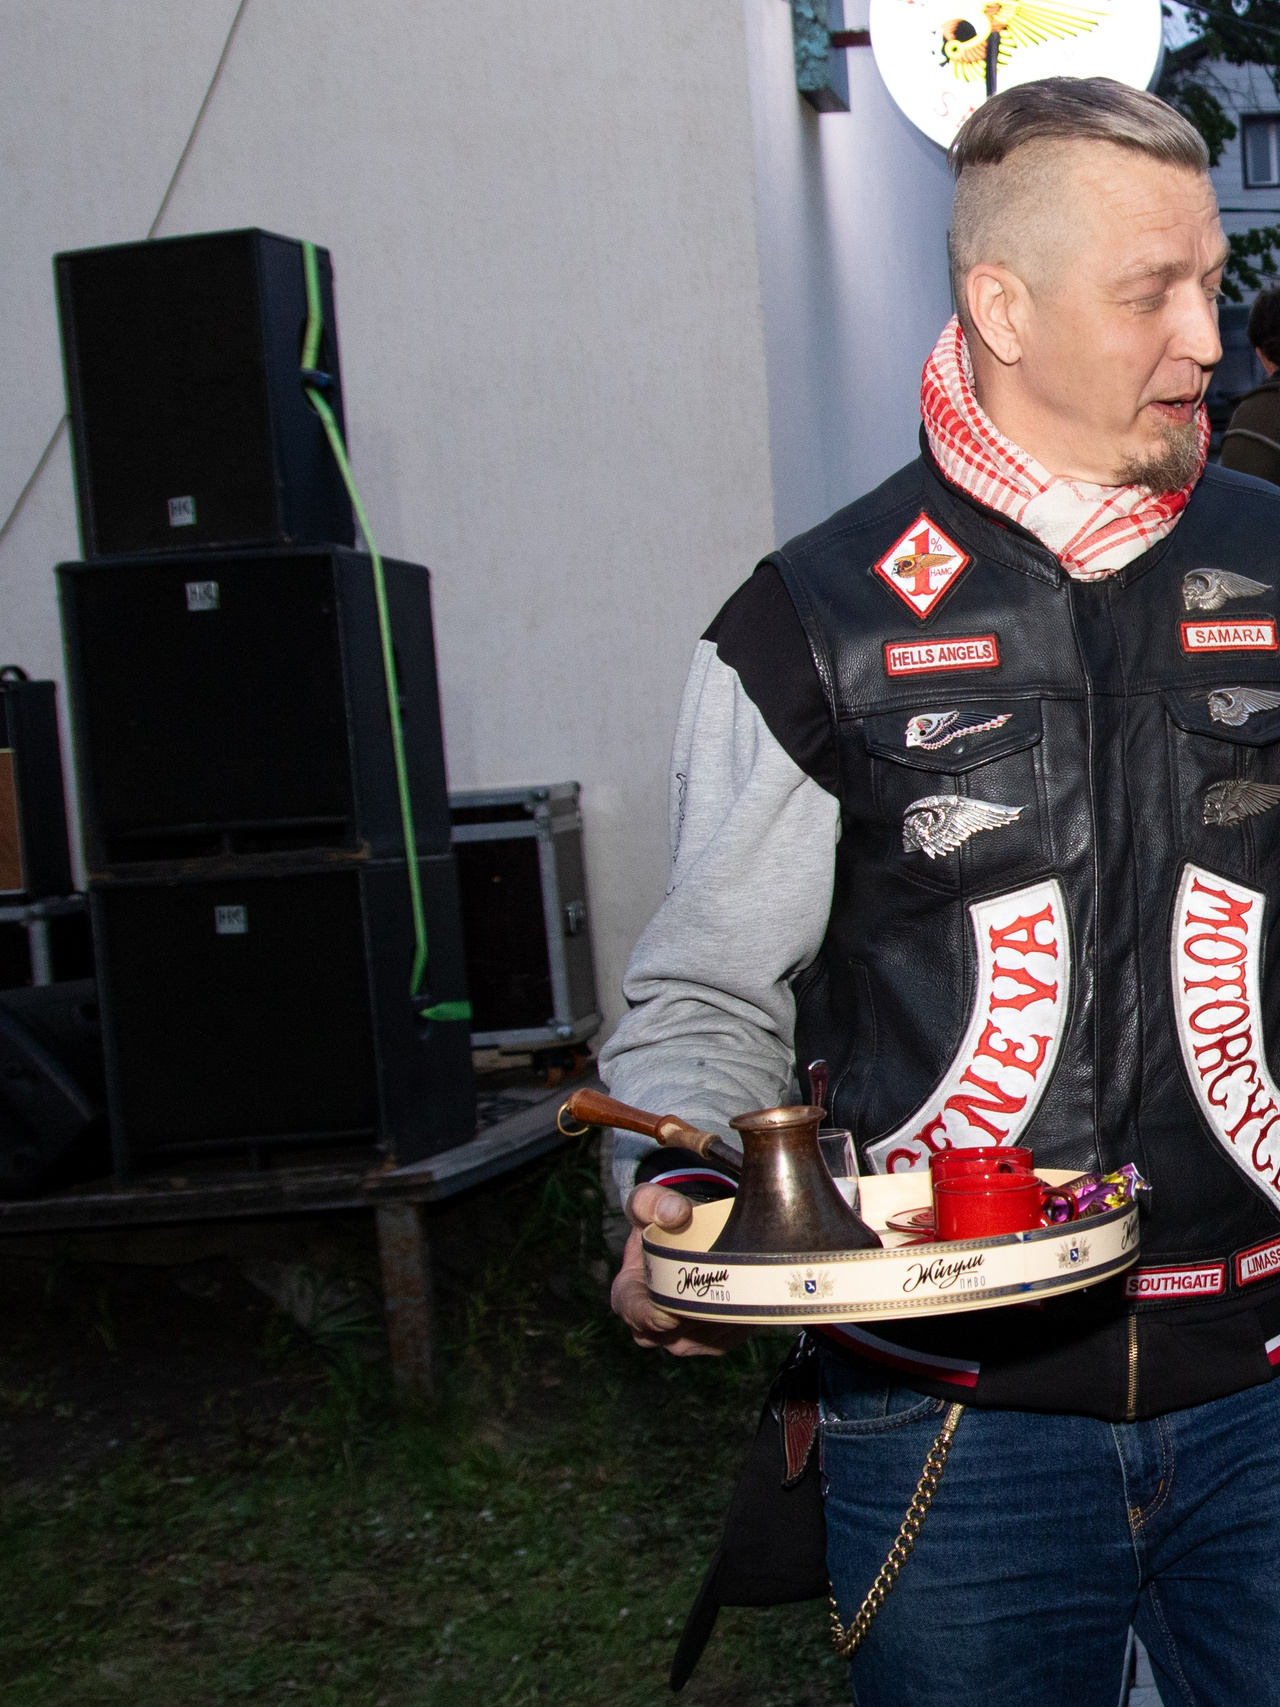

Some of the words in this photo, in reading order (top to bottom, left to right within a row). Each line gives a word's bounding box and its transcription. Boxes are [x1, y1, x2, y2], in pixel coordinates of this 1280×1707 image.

[930, 567, 953, 577] HAMC
[1194, 628, 1266, 645] SAMARA
[891, 648, 934, 668] HELLS
[937, 643, 993, 663] ANGELS
[677, 1266, 729, 1297] Жигули
[903, 1254, 985, 1293] Жигули
[1128, 1272, 1220, 1293] SOUTHGATE
